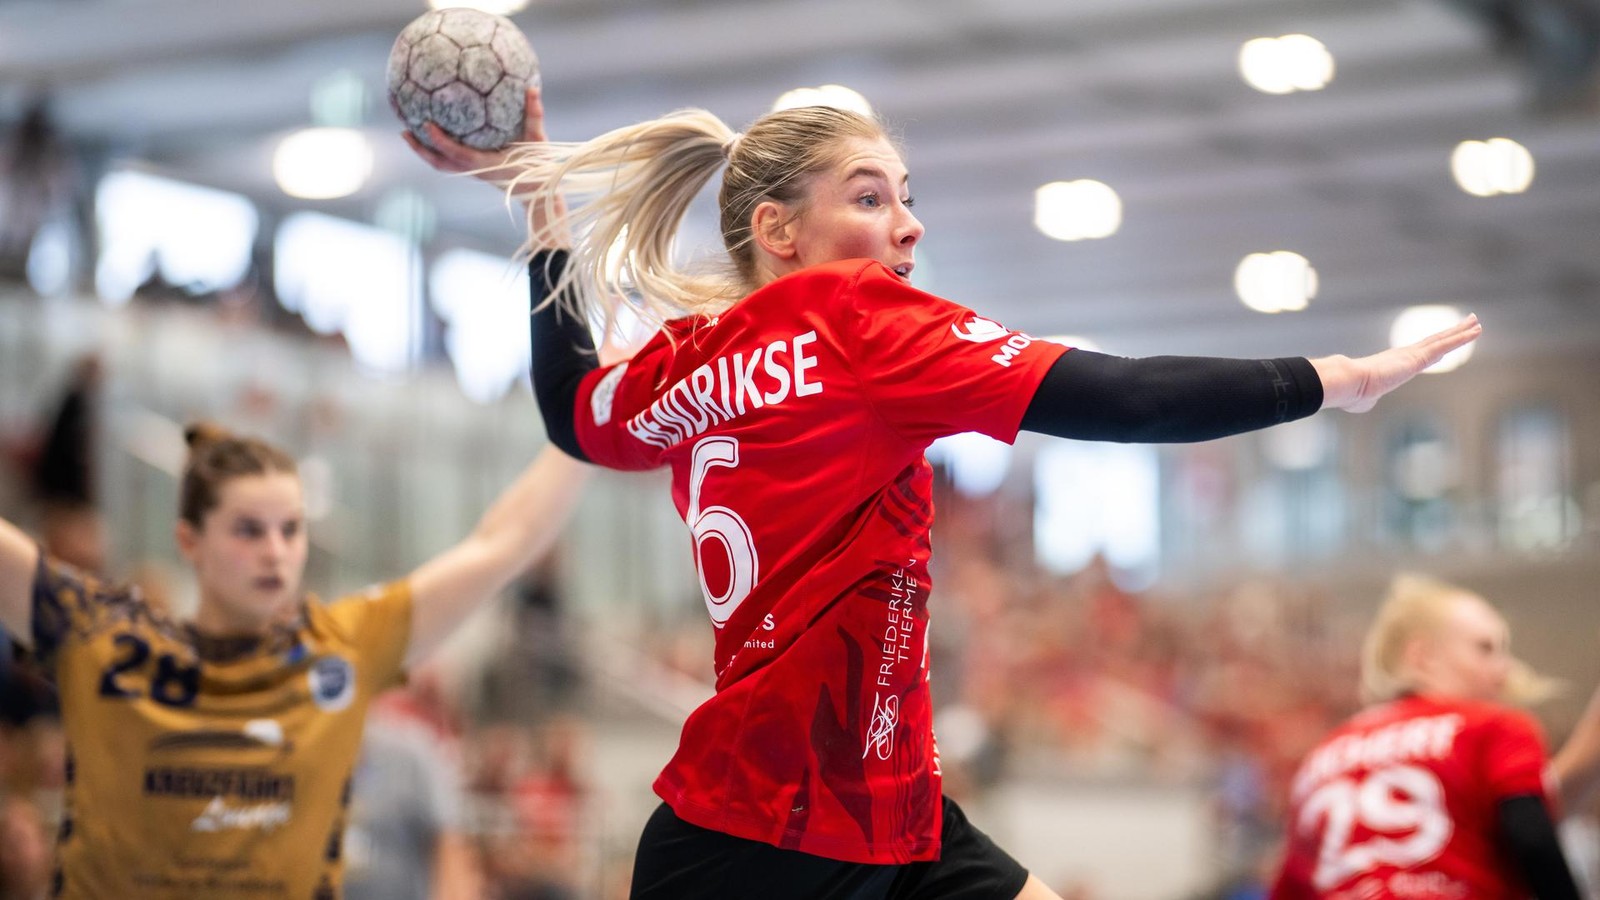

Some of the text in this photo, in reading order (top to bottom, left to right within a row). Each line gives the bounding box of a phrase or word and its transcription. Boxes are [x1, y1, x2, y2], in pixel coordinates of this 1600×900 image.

[686, 435, 759, 629] 6
[99, 634, 201, 708] 28
[1297, 762, 1455, 889] 29
